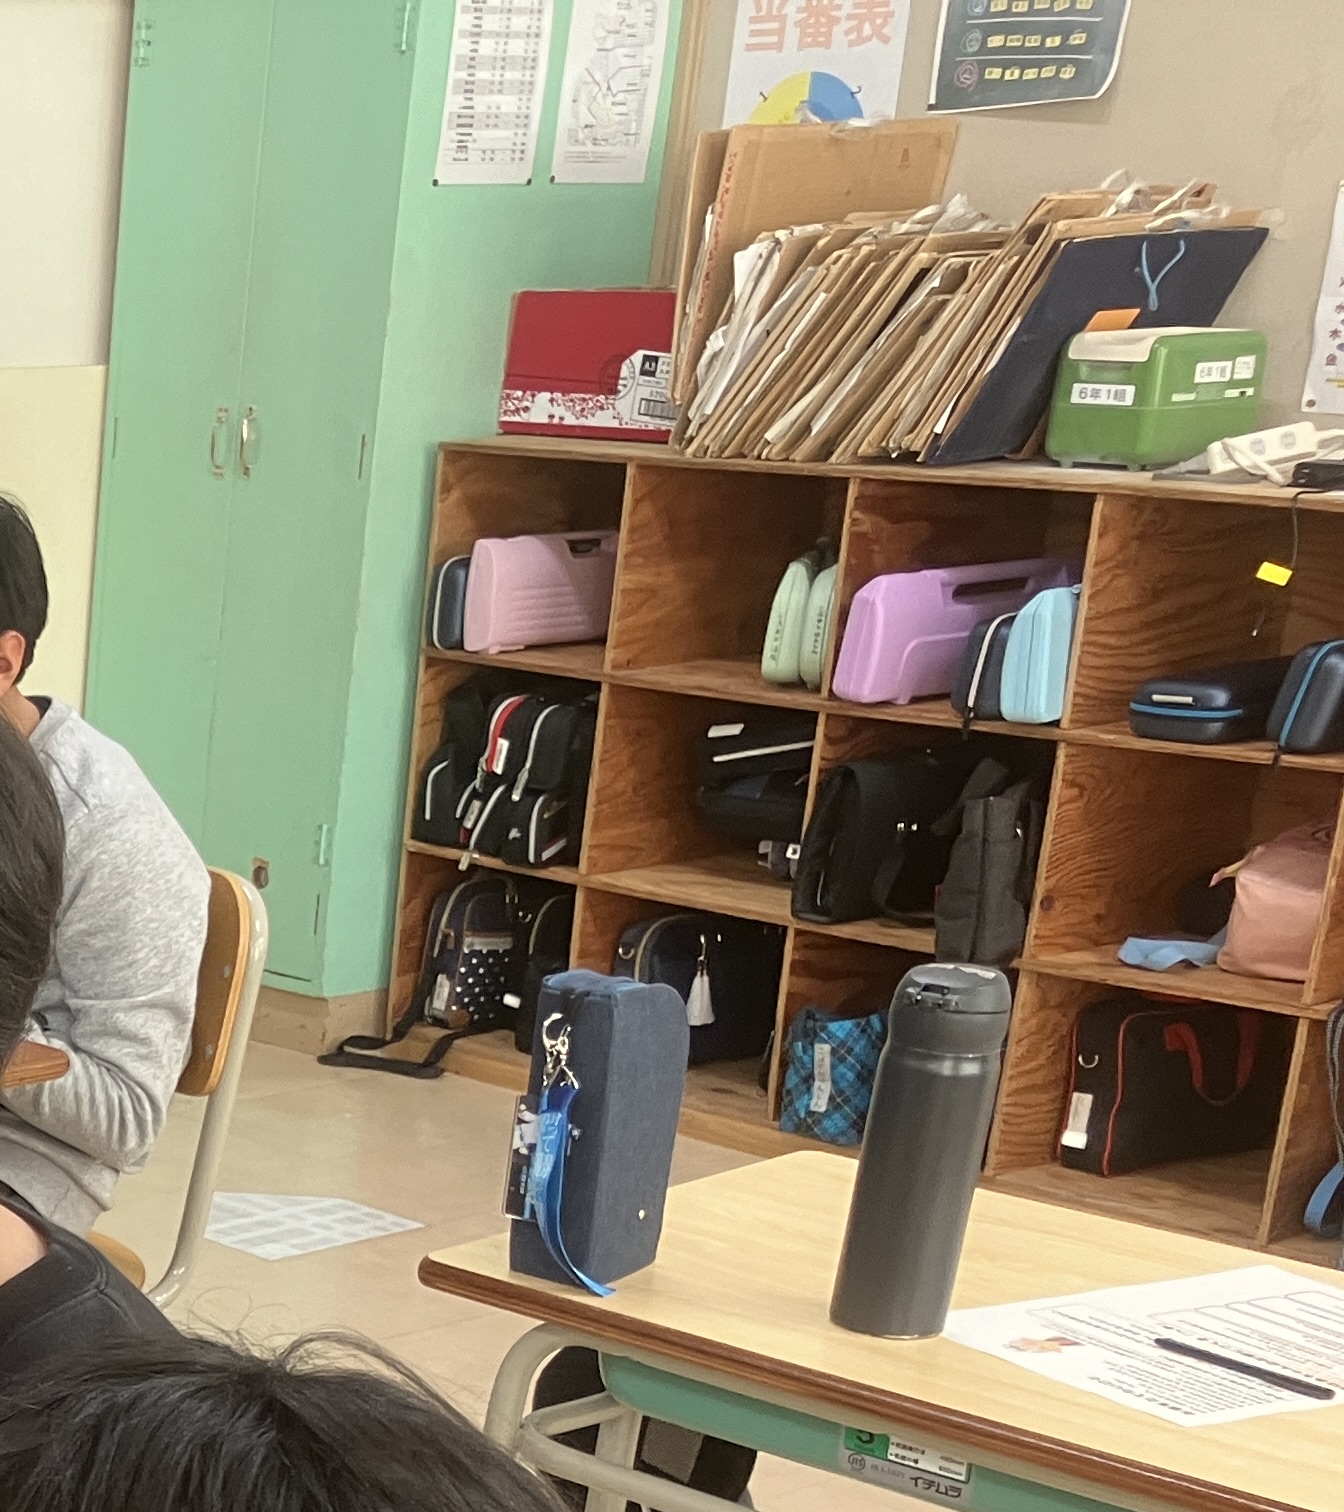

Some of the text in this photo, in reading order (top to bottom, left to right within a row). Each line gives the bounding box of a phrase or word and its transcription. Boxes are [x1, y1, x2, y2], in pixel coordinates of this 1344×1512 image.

[743, 0, 896, 53] 当番表
[1078, 387, 1127, 403] 6年1組
[910, 1475, 963, 1498] イチムラ
